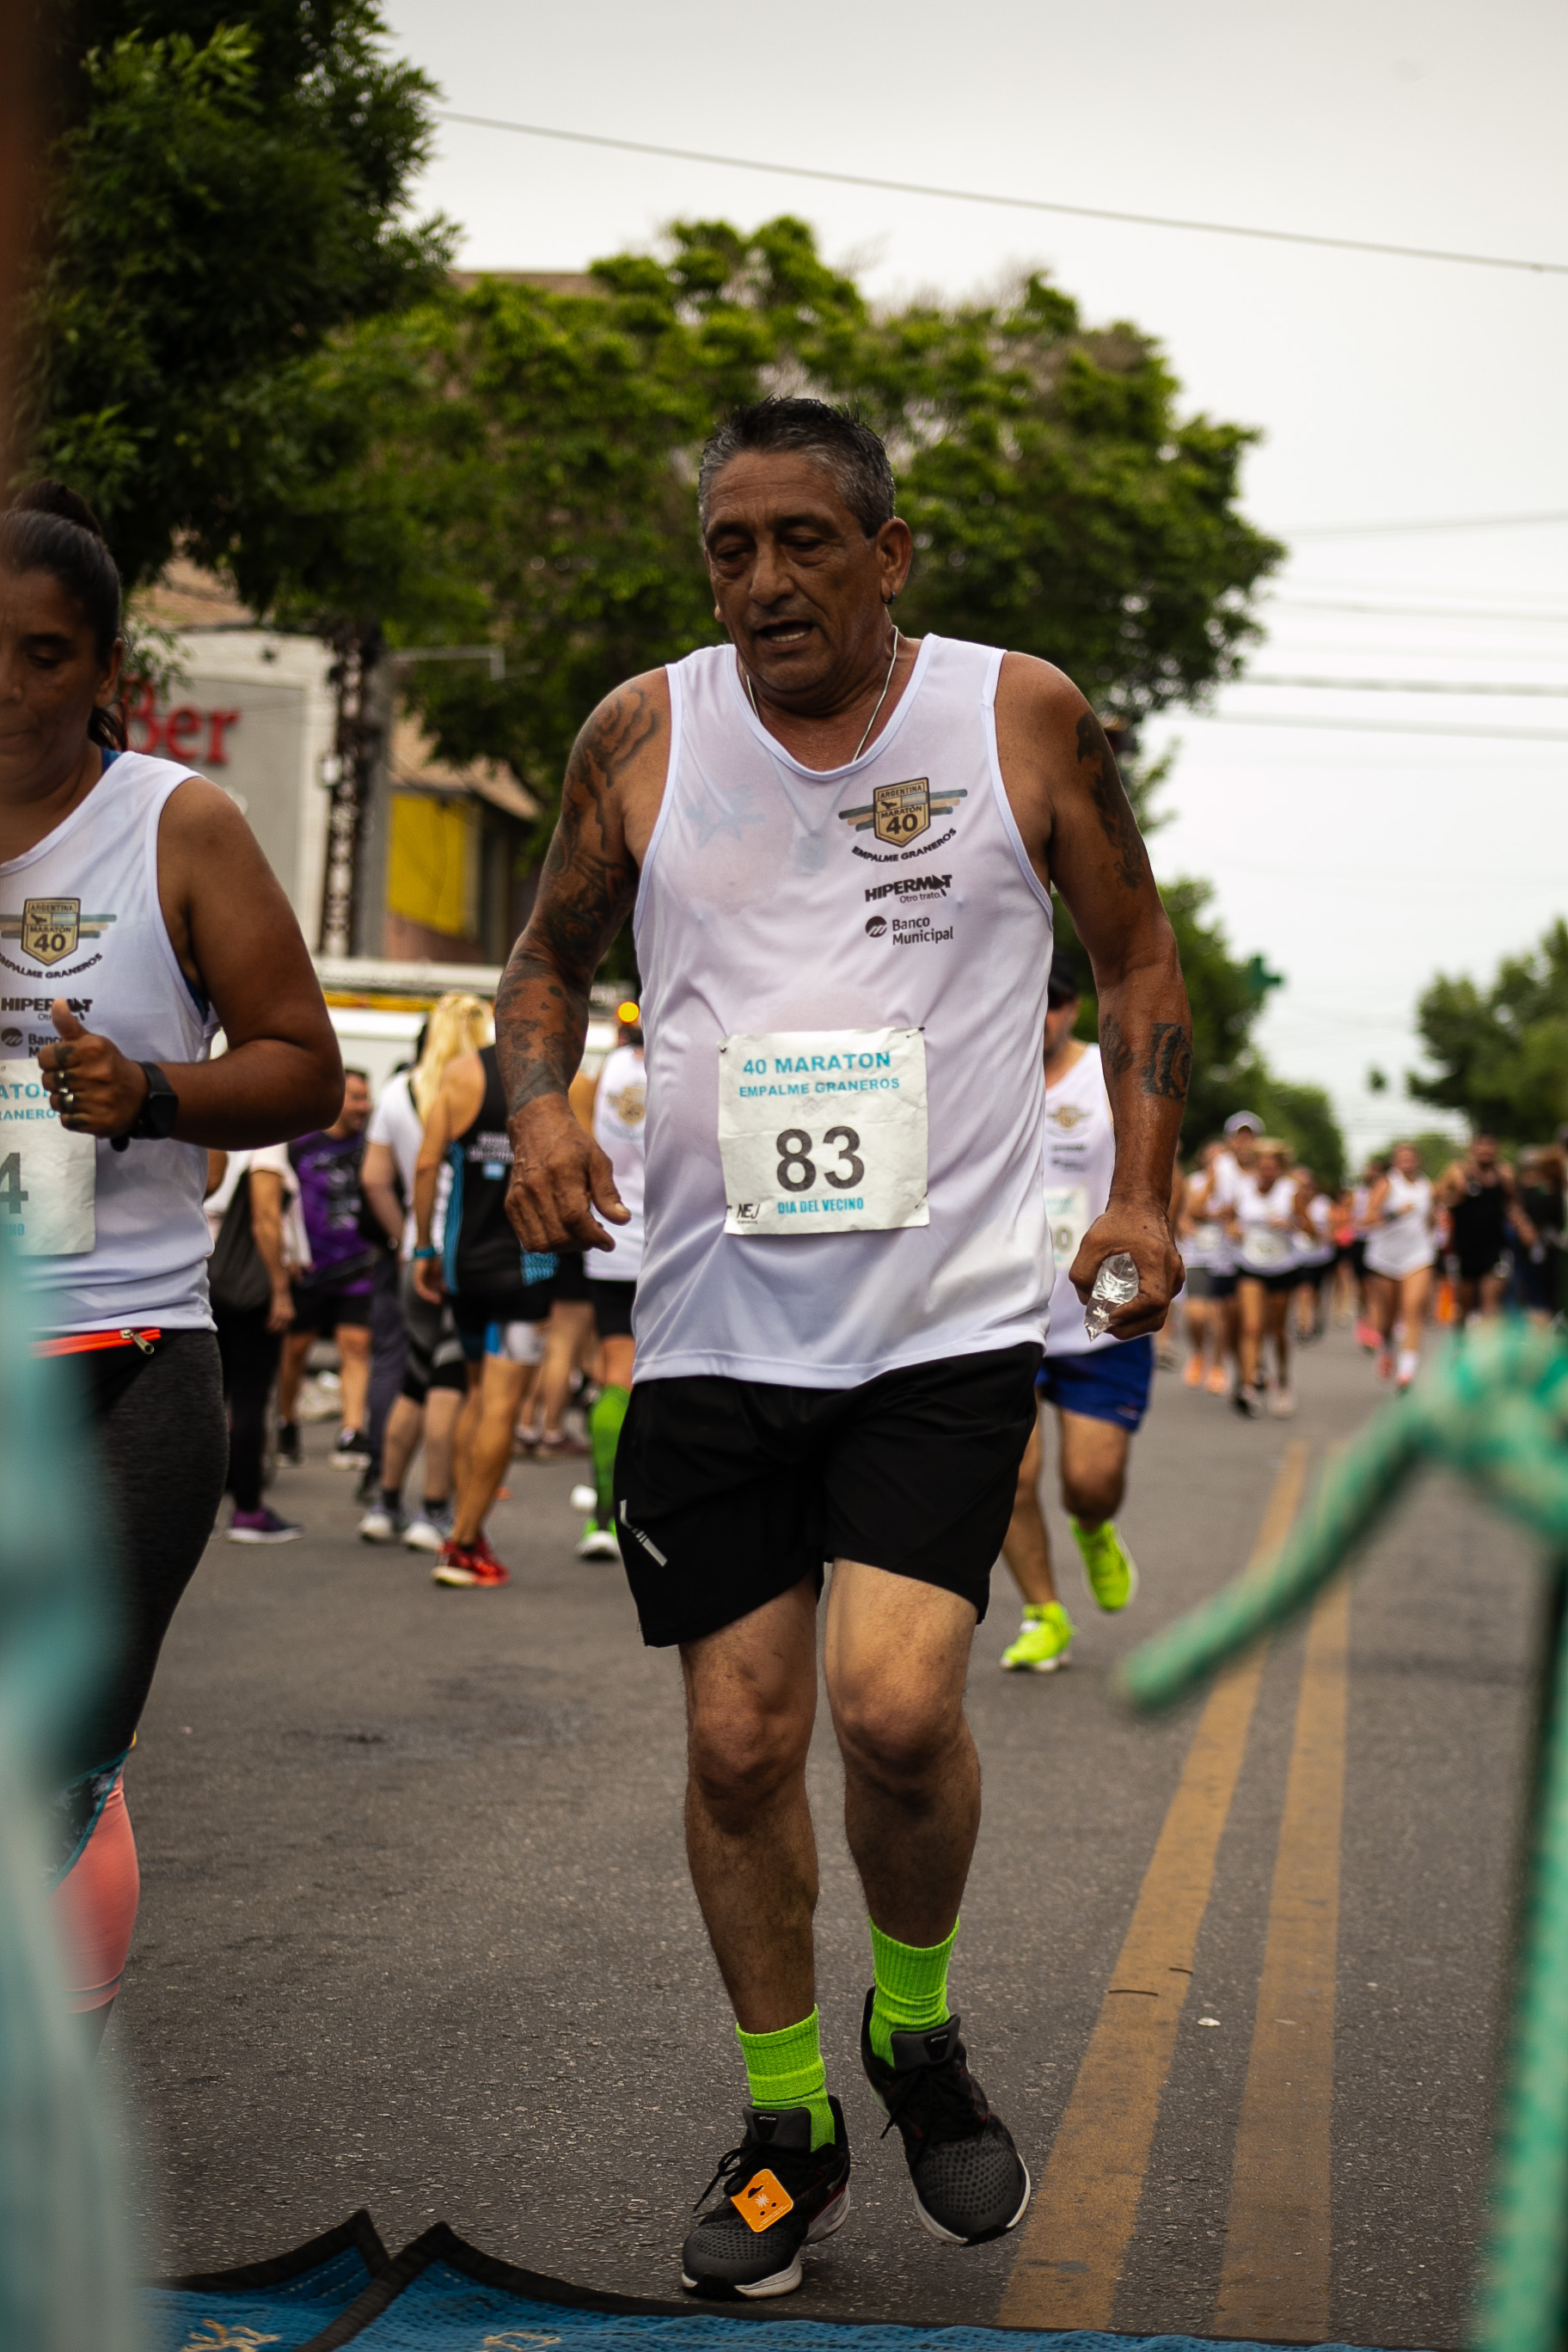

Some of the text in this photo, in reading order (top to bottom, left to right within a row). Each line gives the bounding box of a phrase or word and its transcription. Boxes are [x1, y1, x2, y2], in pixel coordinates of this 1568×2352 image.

[879, 785, 922, 799] ARGENTINA
[880, 803, 922, 819] MARATÓN
[885, 813, 918, 835] 40
[851, 828, 957, 863] EMPALME GRANEROS
[865, 874, 952, 903] HIPERMAT
[899, 891, 942, 903] Otro trato.
[31, 903, 74, 912] ARGENTINA
[891, 916, 930, 932] Banco
[34, 934, 66, 952] 40
[892, 927, 953, 946] Municipal
[46, 952, 102, 978] GRANEROS
[743, 1051, 891, 1075] 40 MARATON
[739, 1078, 900, 1098] EMPALME GRANEROS
[775, 1125, 865, 1192] 83
[777, 1197, 864, 1214] DIA DEL VECINO
